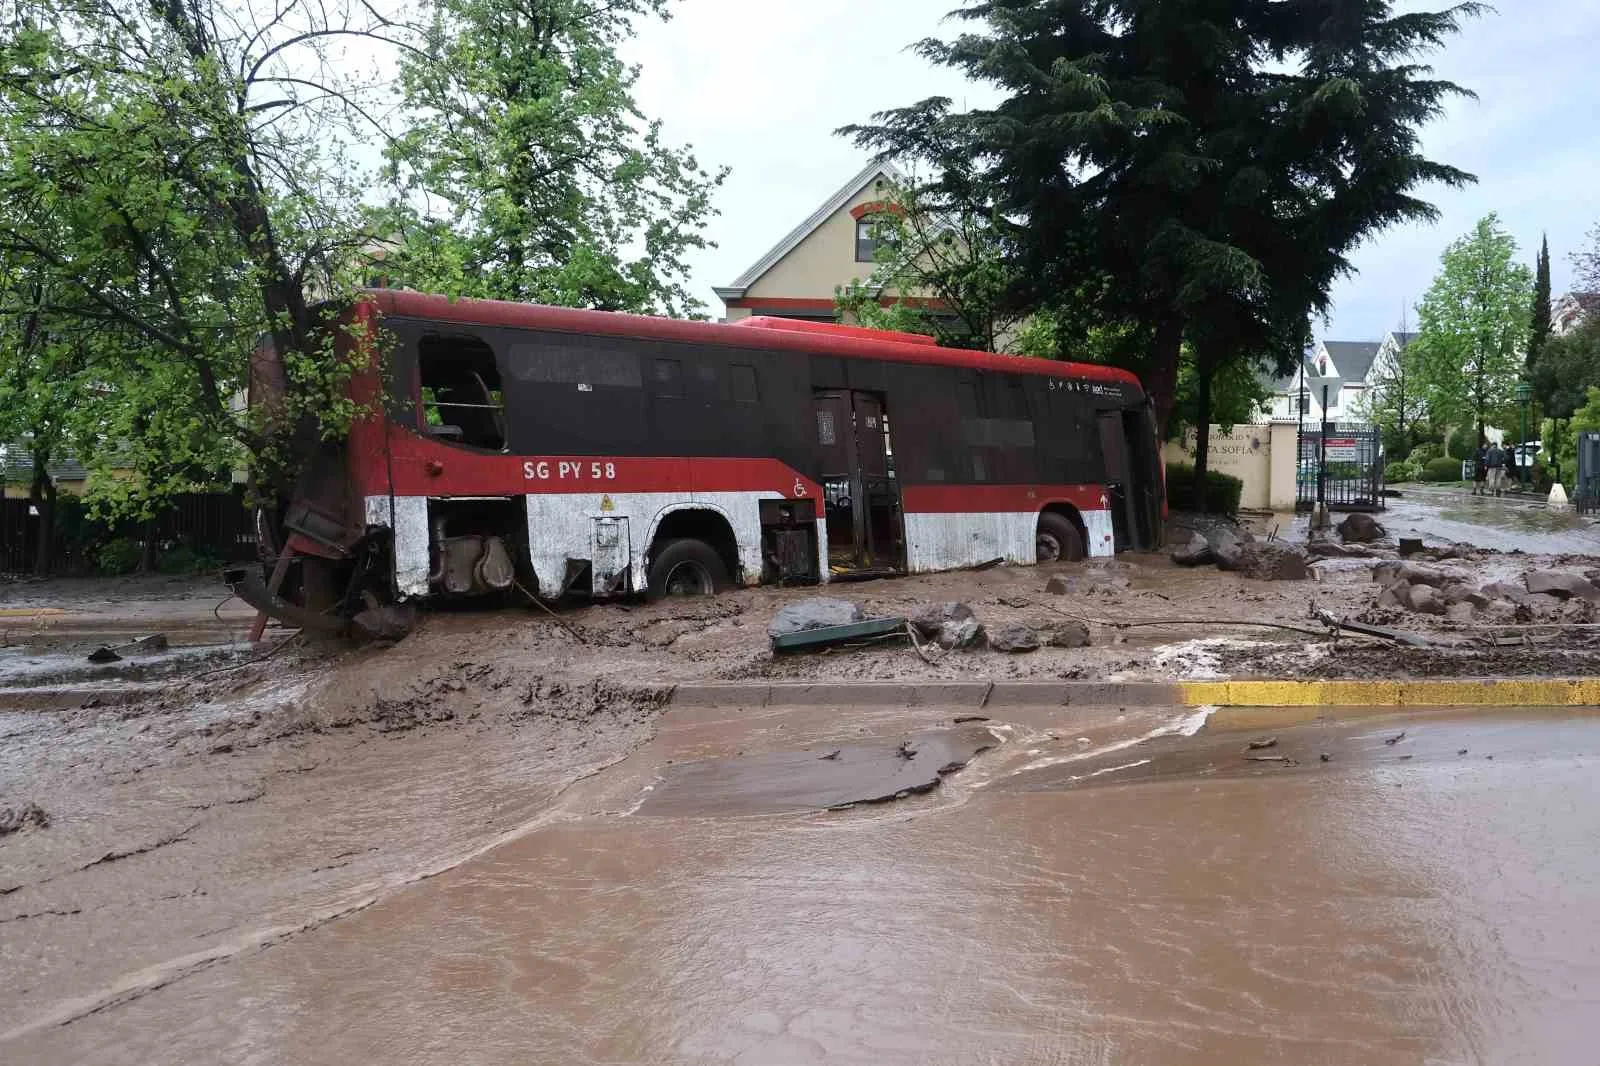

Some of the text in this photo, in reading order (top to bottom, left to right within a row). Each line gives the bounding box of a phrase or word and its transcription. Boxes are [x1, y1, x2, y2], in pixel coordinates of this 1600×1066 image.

[523, 461, 615, 479] SG PY 58
